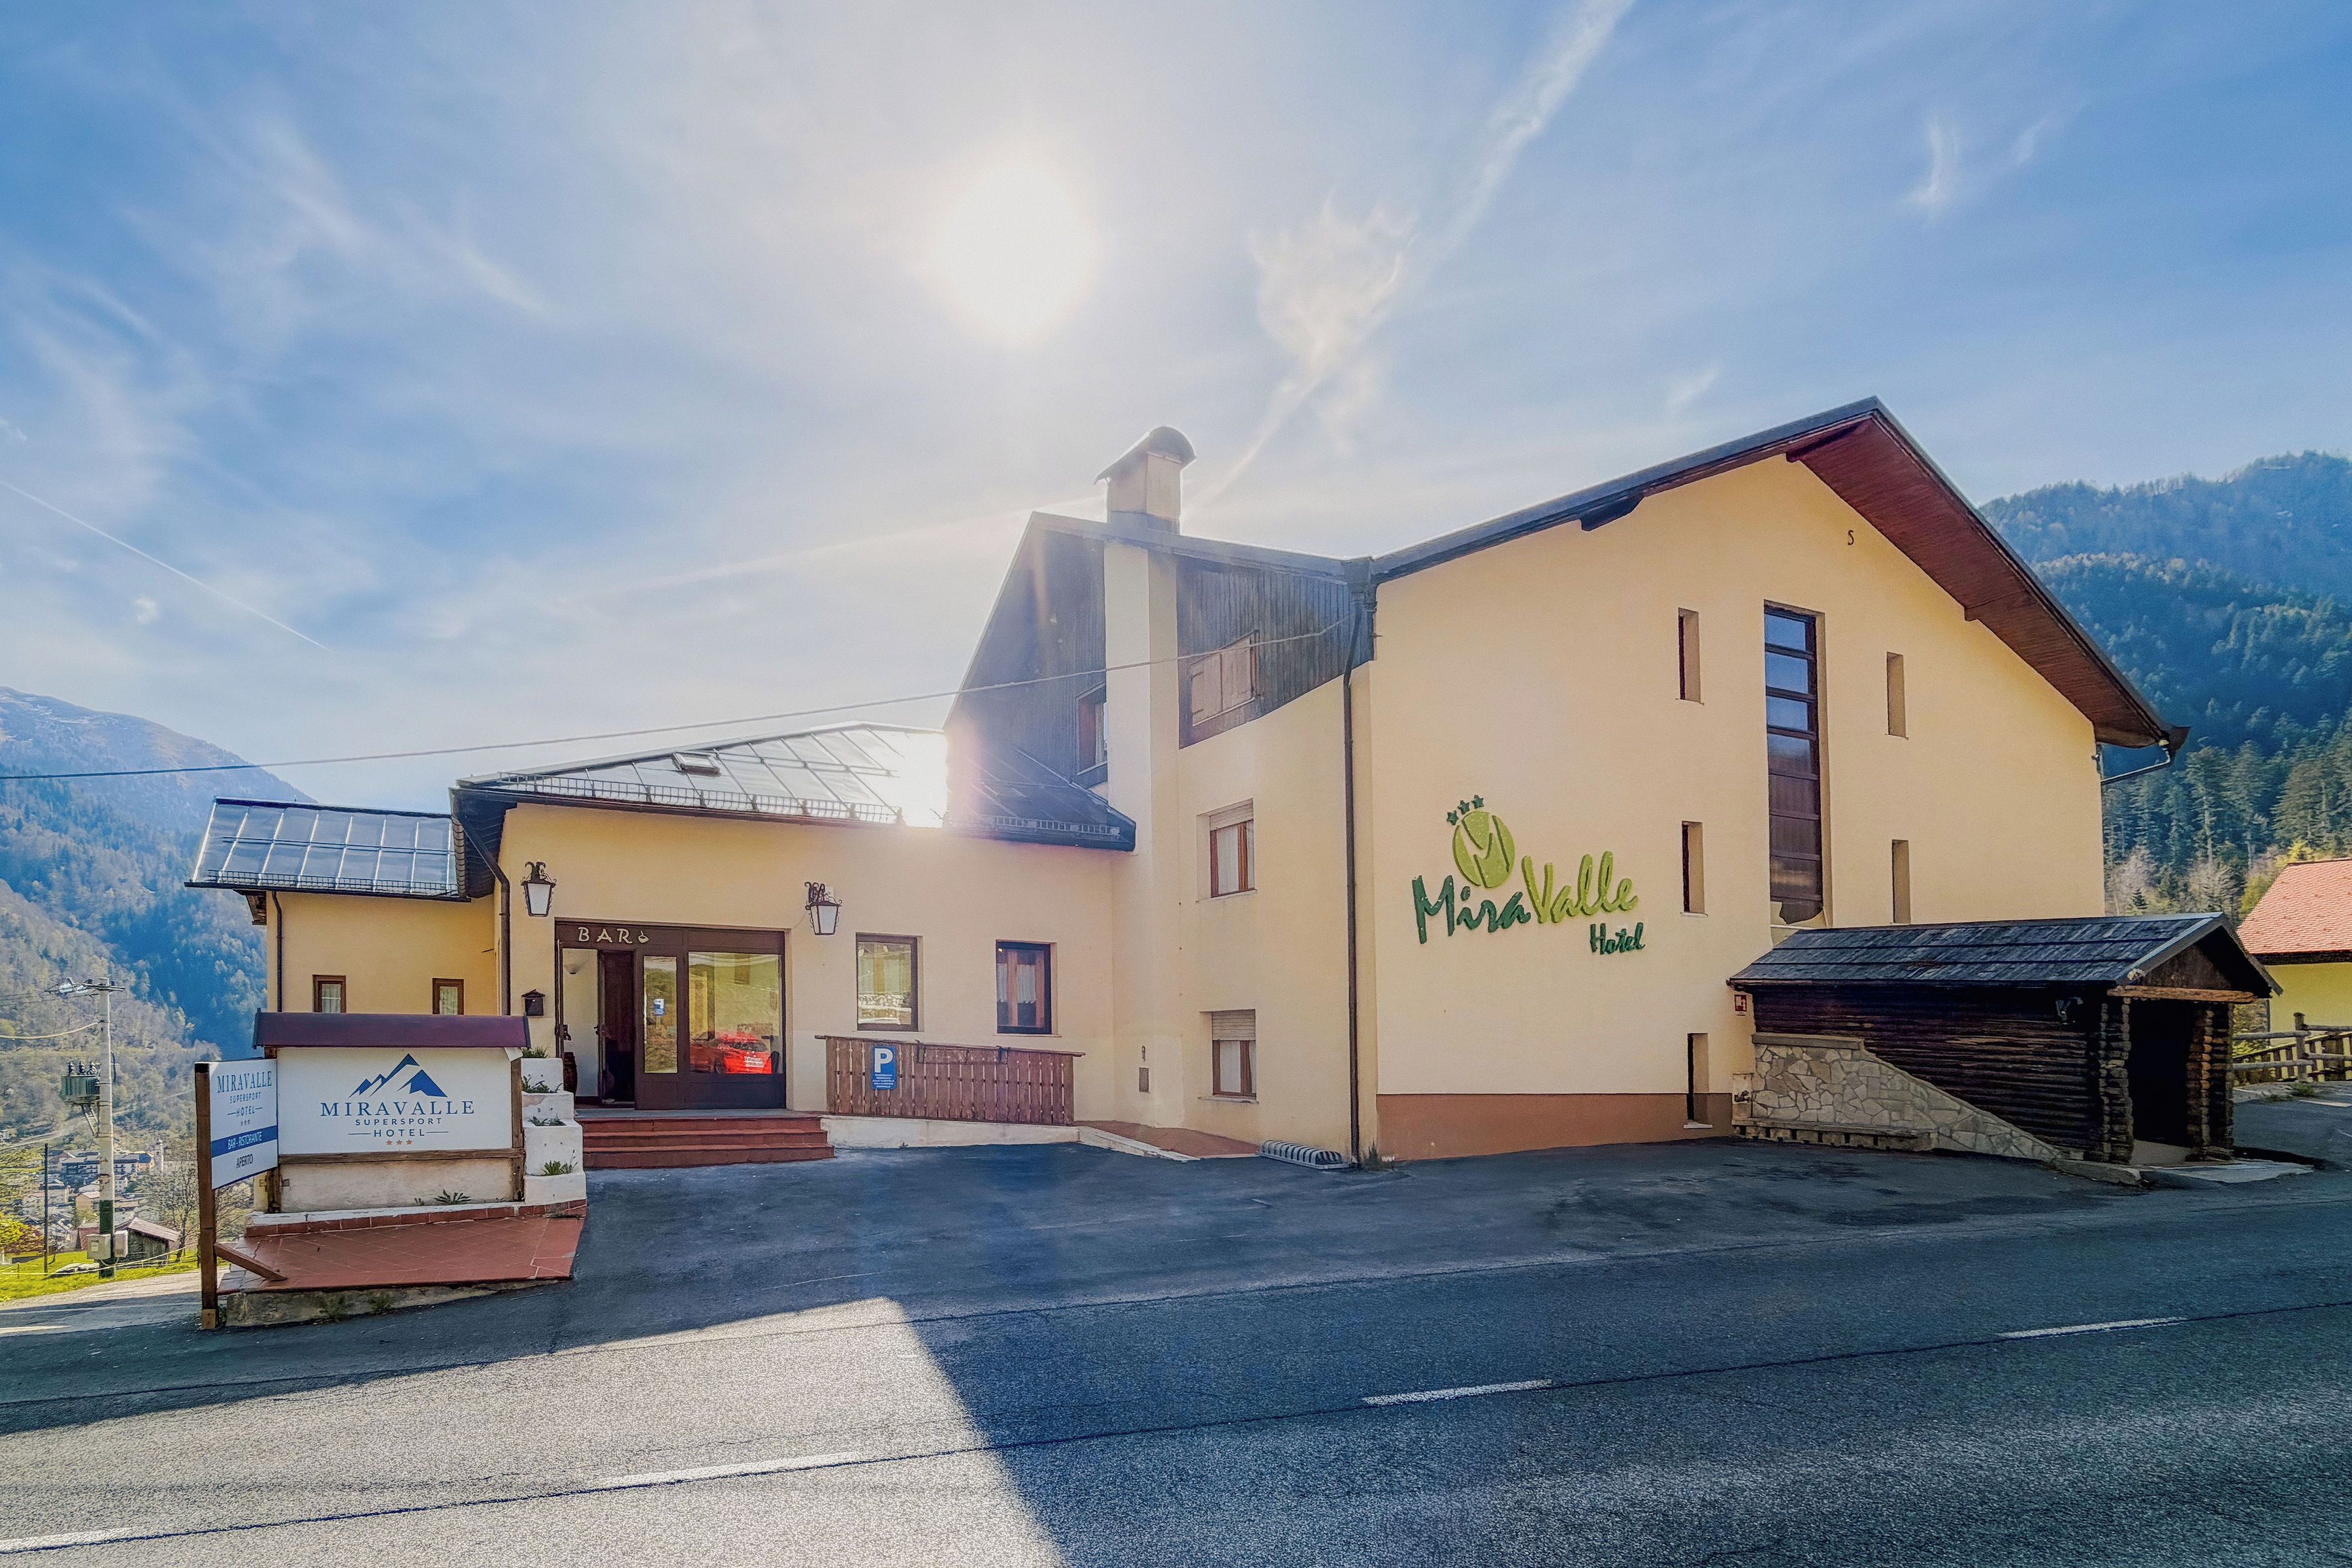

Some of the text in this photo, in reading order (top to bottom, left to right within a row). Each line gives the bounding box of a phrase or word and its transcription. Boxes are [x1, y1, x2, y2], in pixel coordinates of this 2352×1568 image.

[1412, 851, 1639, 945] MiraValle
[578, 926, 633, 944] BAR
[1590, 922, 1646, 955] Hotel
[874, 1047, 893, 1073] P
[217, 1071, 272, 1094] MIRAVALLE
[229, 1091, 262, 1104] SUPERSPORT
[236, 1105, 255, 1117] HOTEL
[320, 1100, 474, 1117] MIRAVALLE
[355, 1117, 442, 1126] SUPERSPORT
[373, 1128, 425, 1137] HOTEL
[236, 1153, 253, 1168] APERTO
